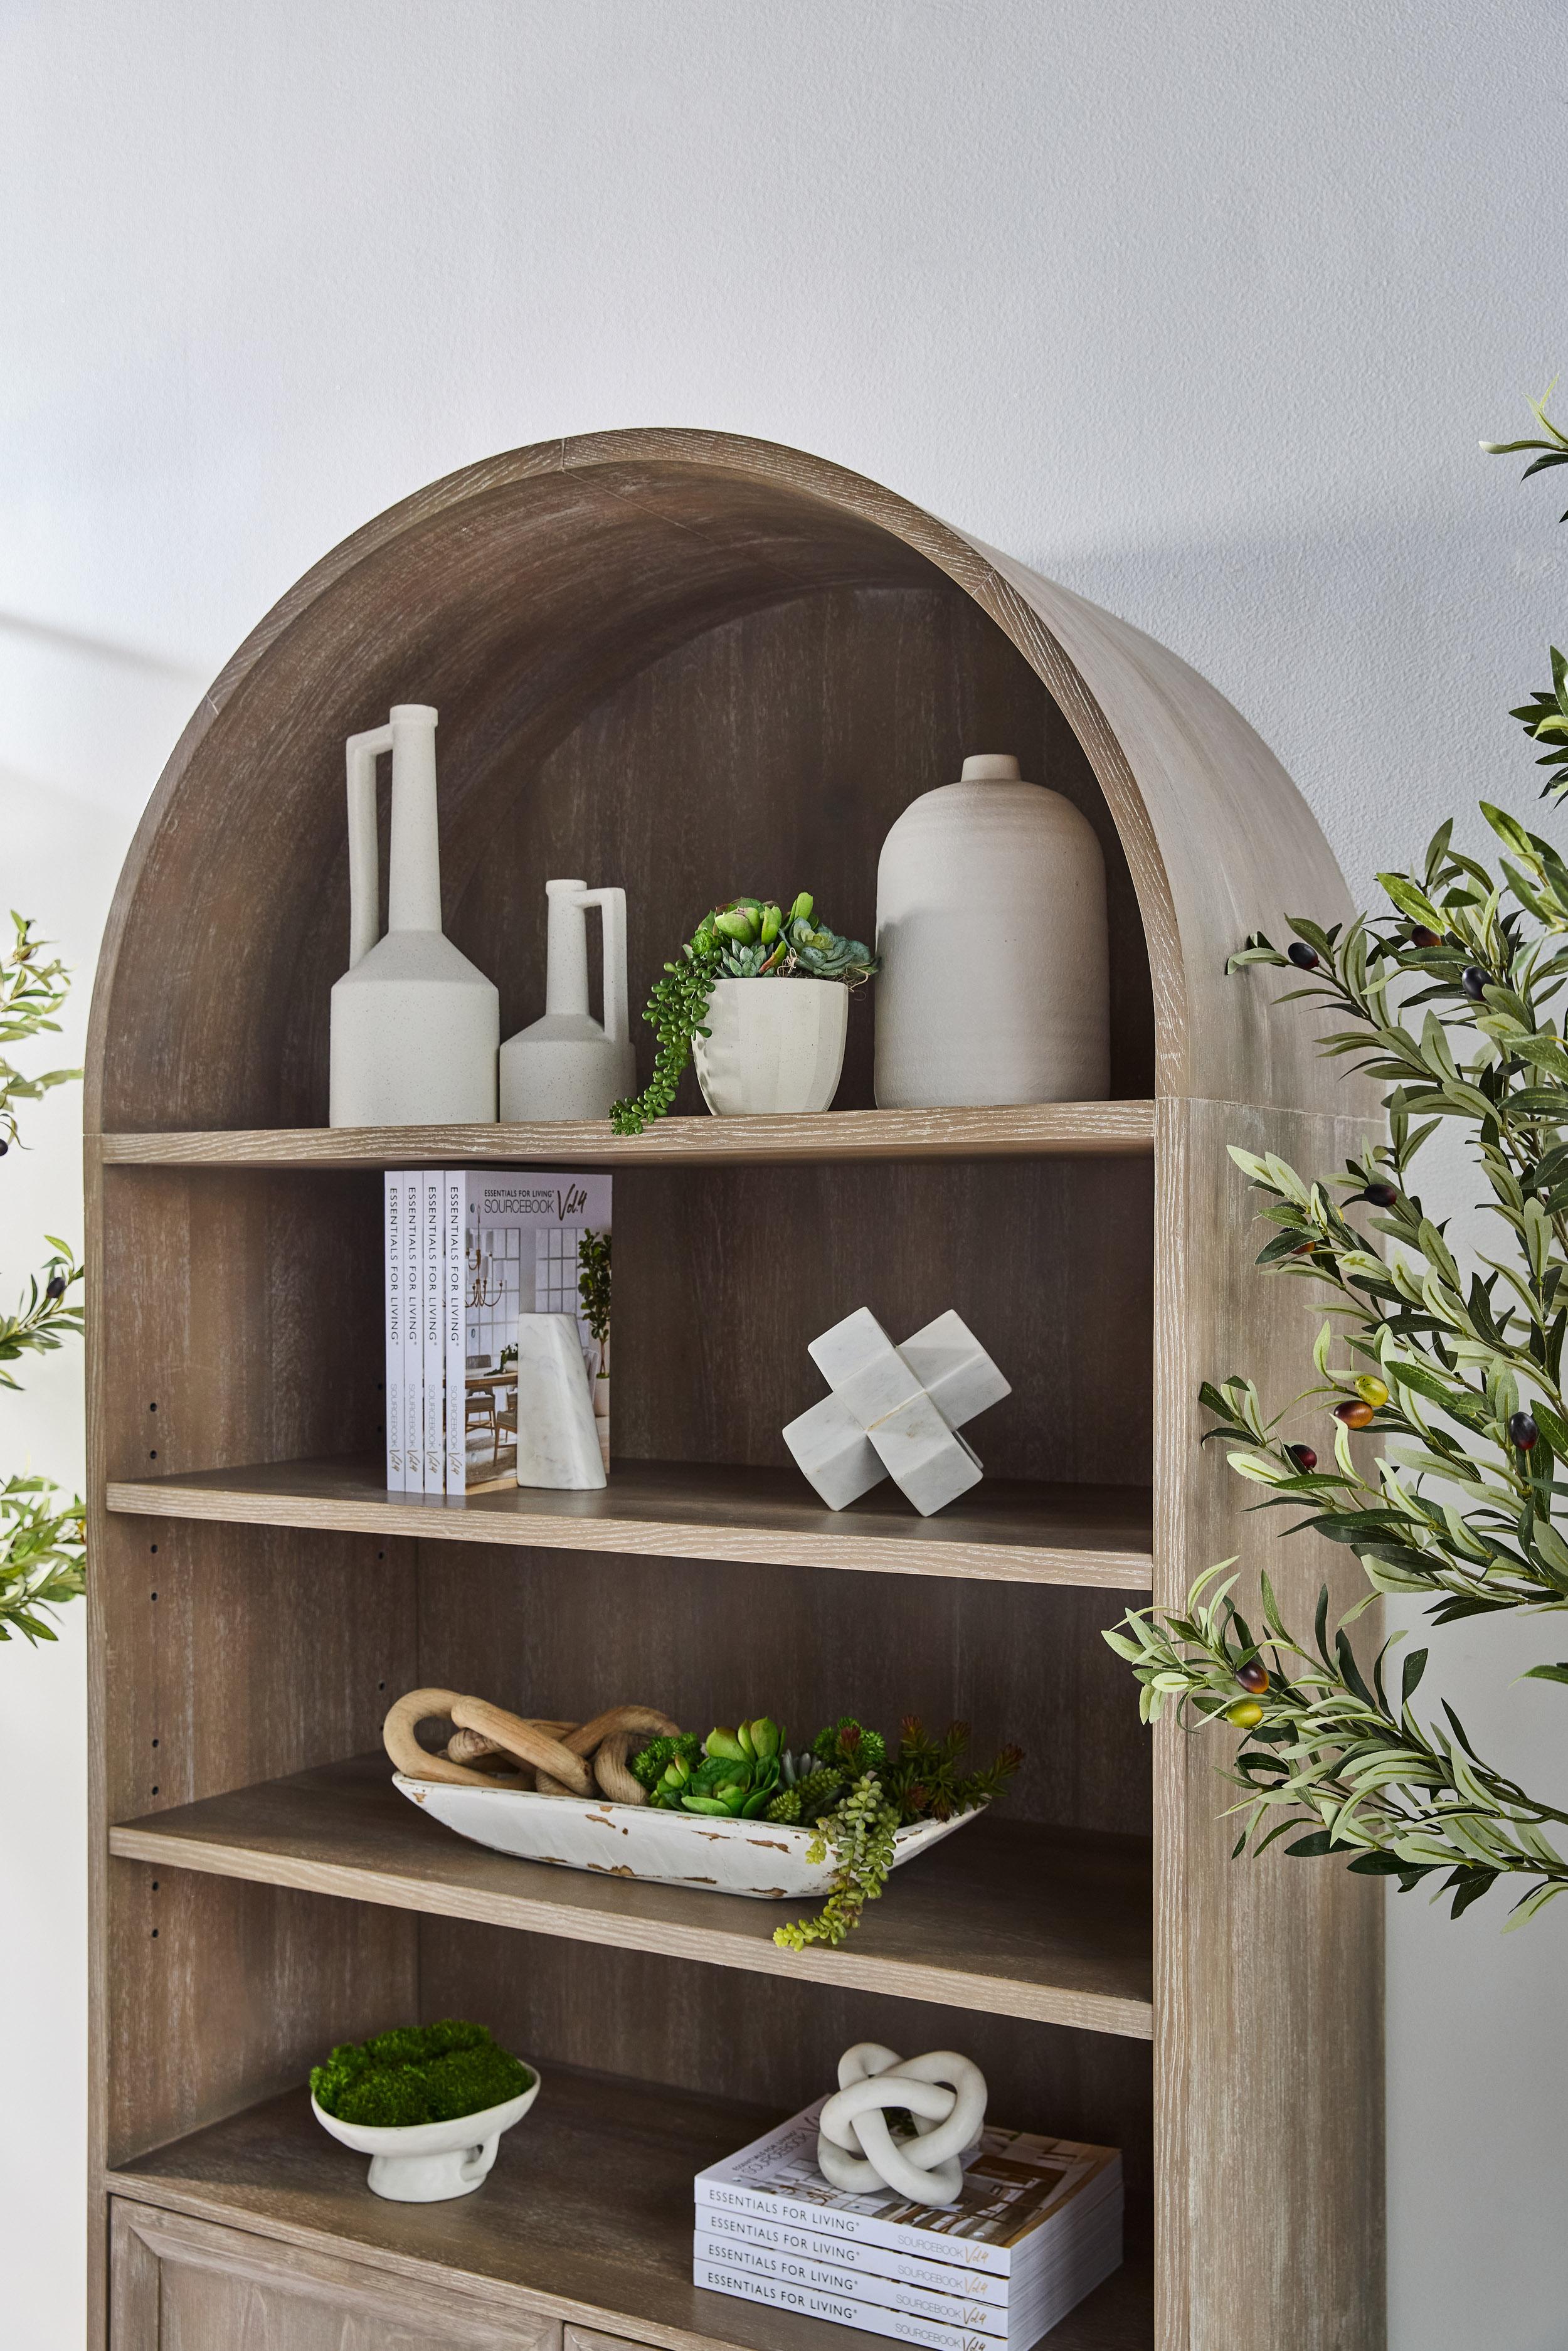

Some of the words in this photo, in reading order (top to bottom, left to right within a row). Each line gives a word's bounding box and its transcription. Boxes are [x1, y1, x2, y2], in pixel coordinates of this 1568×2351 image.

[484, 1189, 517, 1197] ESSENTIALS
[519, 1189, 531, 1197] FOR
[484, 1199, 554, 1214] SOURCEBOOK
[709, 2189, 778, 2214] ESSENTIALS
[783, 2206, 807, 2221] FOR
[898, 2235, 963, 2258] SOURCEBOOK
[711, 2216, 778, 2242] ESSENTIALS
[783, 2234, 808, 2249] FOR
[898, 2265, 963, 2289] SOURCEBOOK
[707, 2272, 776, 2299] ESSENTIALS
[781, 2291, 805, 2306] FOR
[895, 2323, 961, 2348] SOURCEBOOK
[708, 2244, 776, 2271] ESSENTIALS
[781, 2263, 806, 2278] FOR
[896, 2294, 961, 2319] SOURCEBOOK
